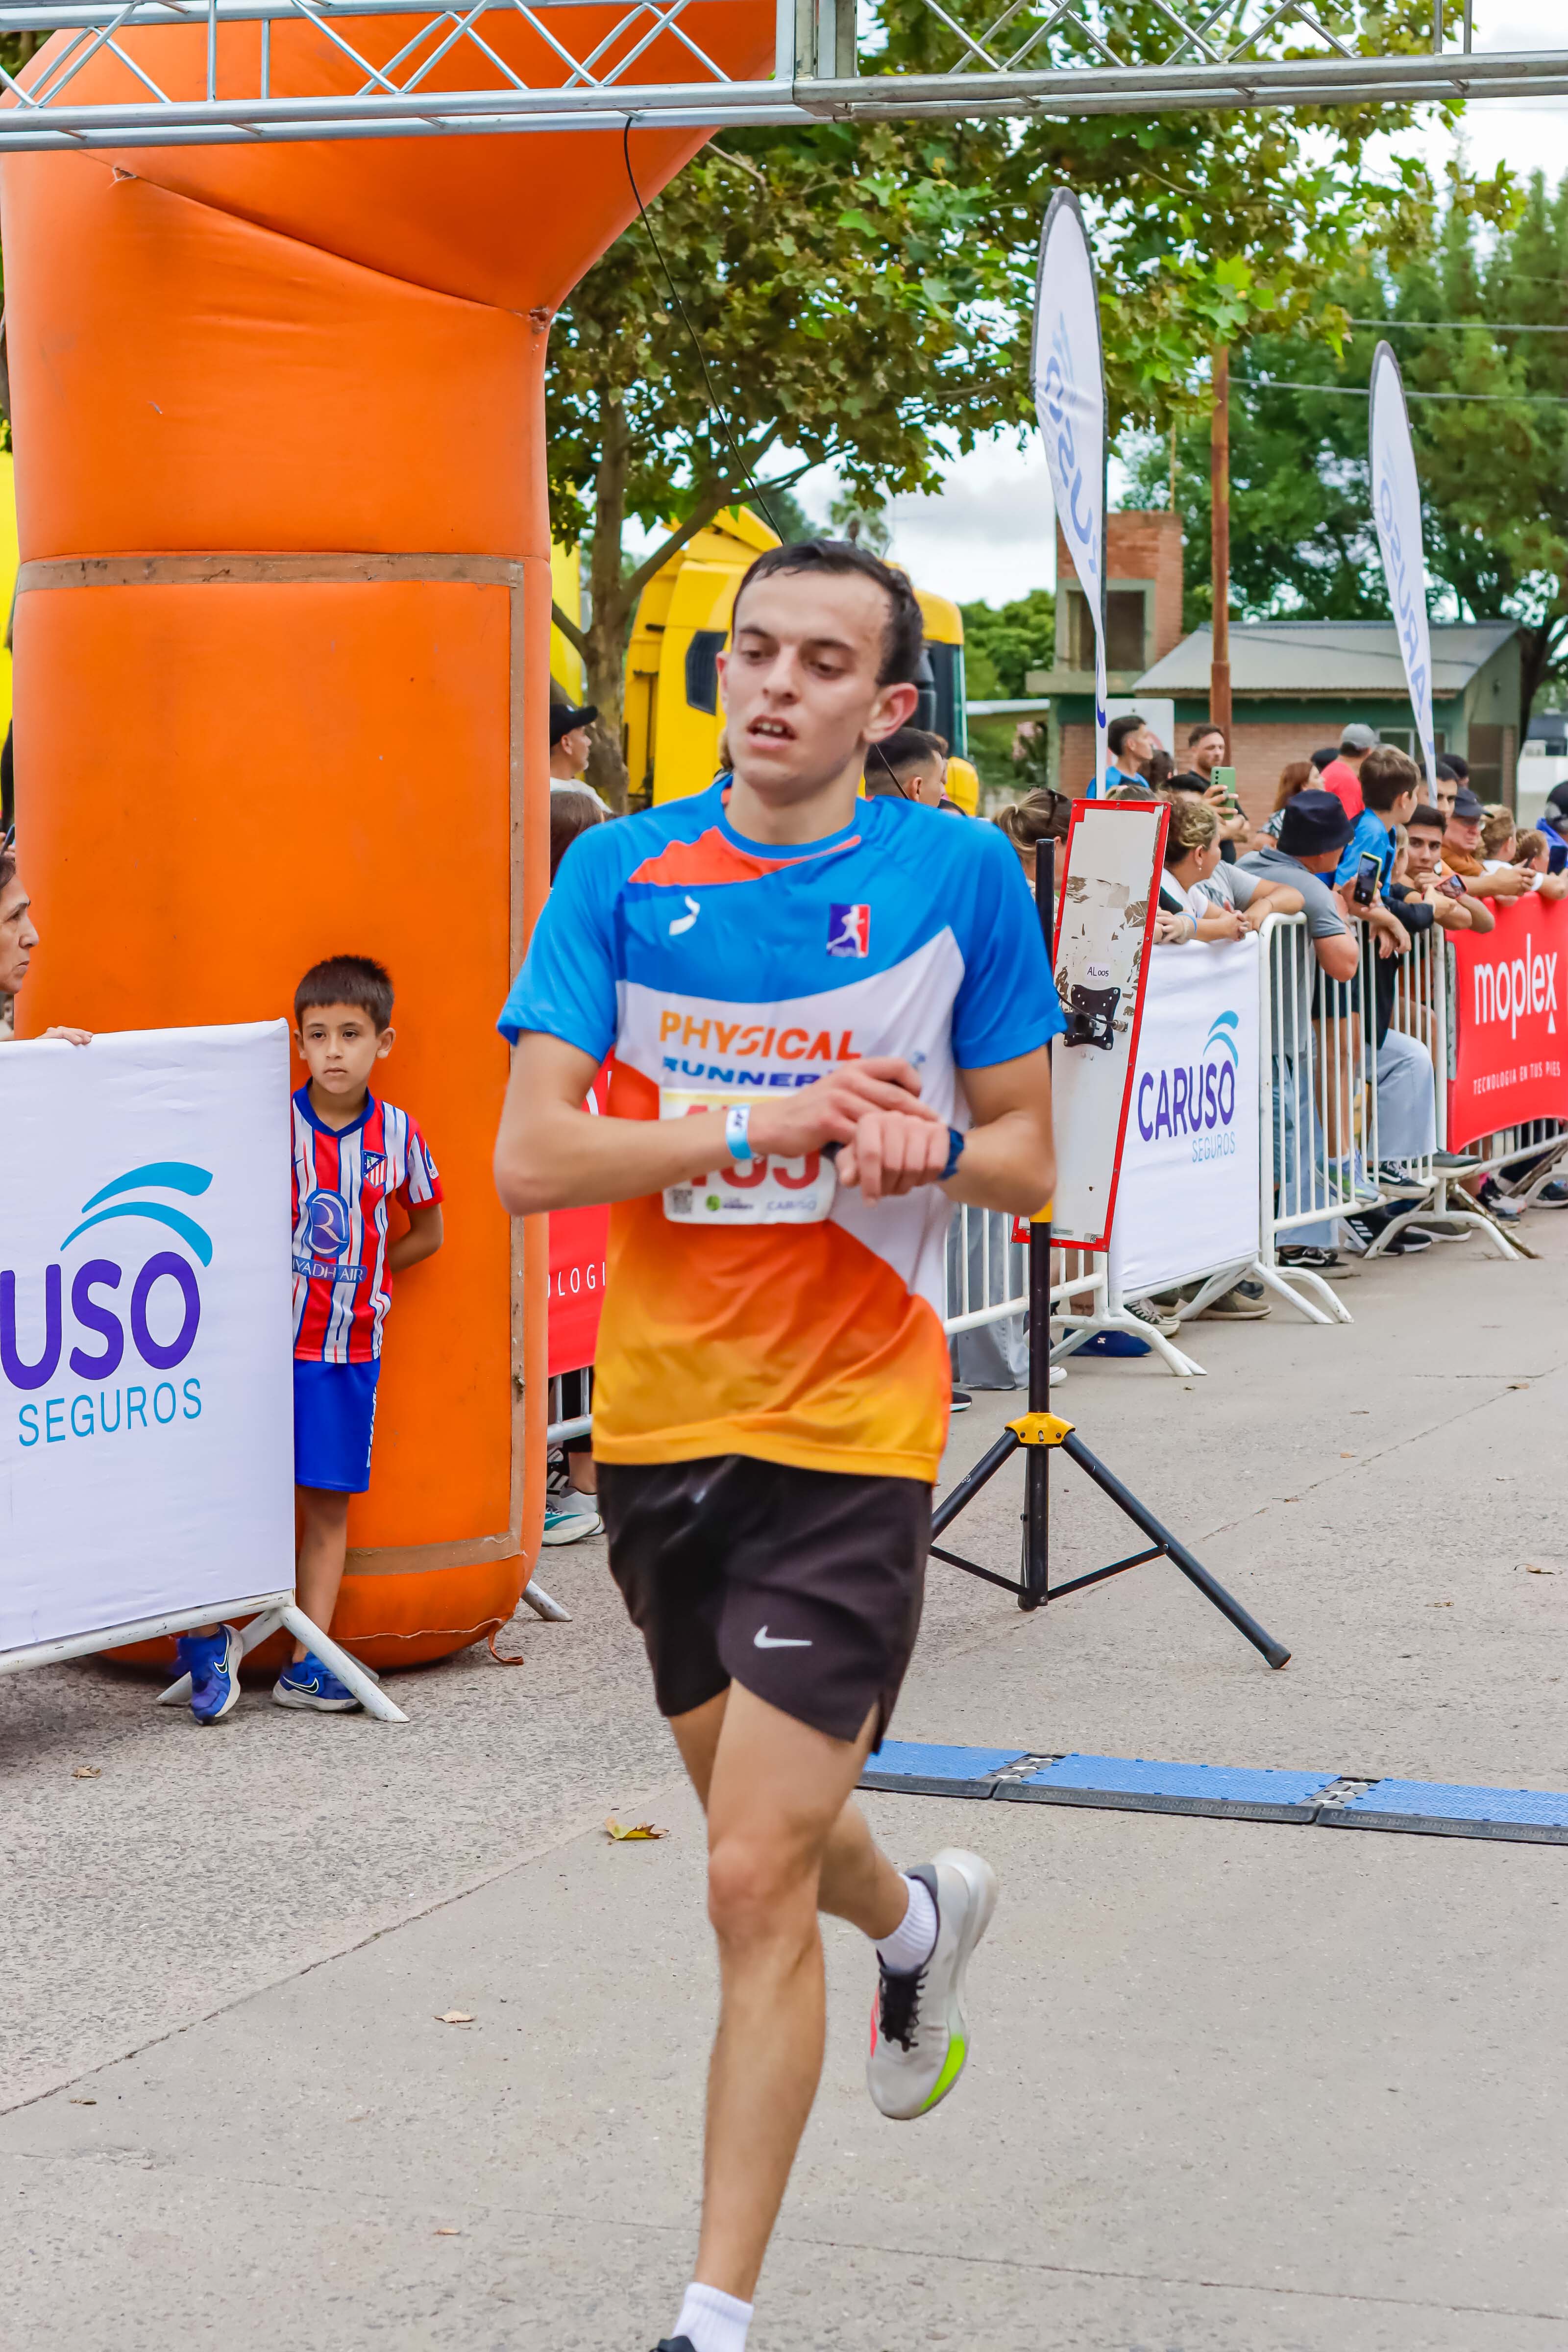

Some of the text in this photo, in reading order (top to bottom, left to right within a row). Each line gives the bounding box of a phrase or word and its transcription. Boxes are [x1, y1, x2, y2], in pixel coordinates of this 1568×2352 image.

[1474, 932, 1558, 1040] moplex
[660, 1010, 862, 1062] PHYSICAL
[1138, 1060, 1235, 1142] CARUSO
[1192, 1131, 1235, 1163] SEGUROS
[339, 1267, 362, 1281] AIR
[19, 1378, 201, 1446] SEGUROS
